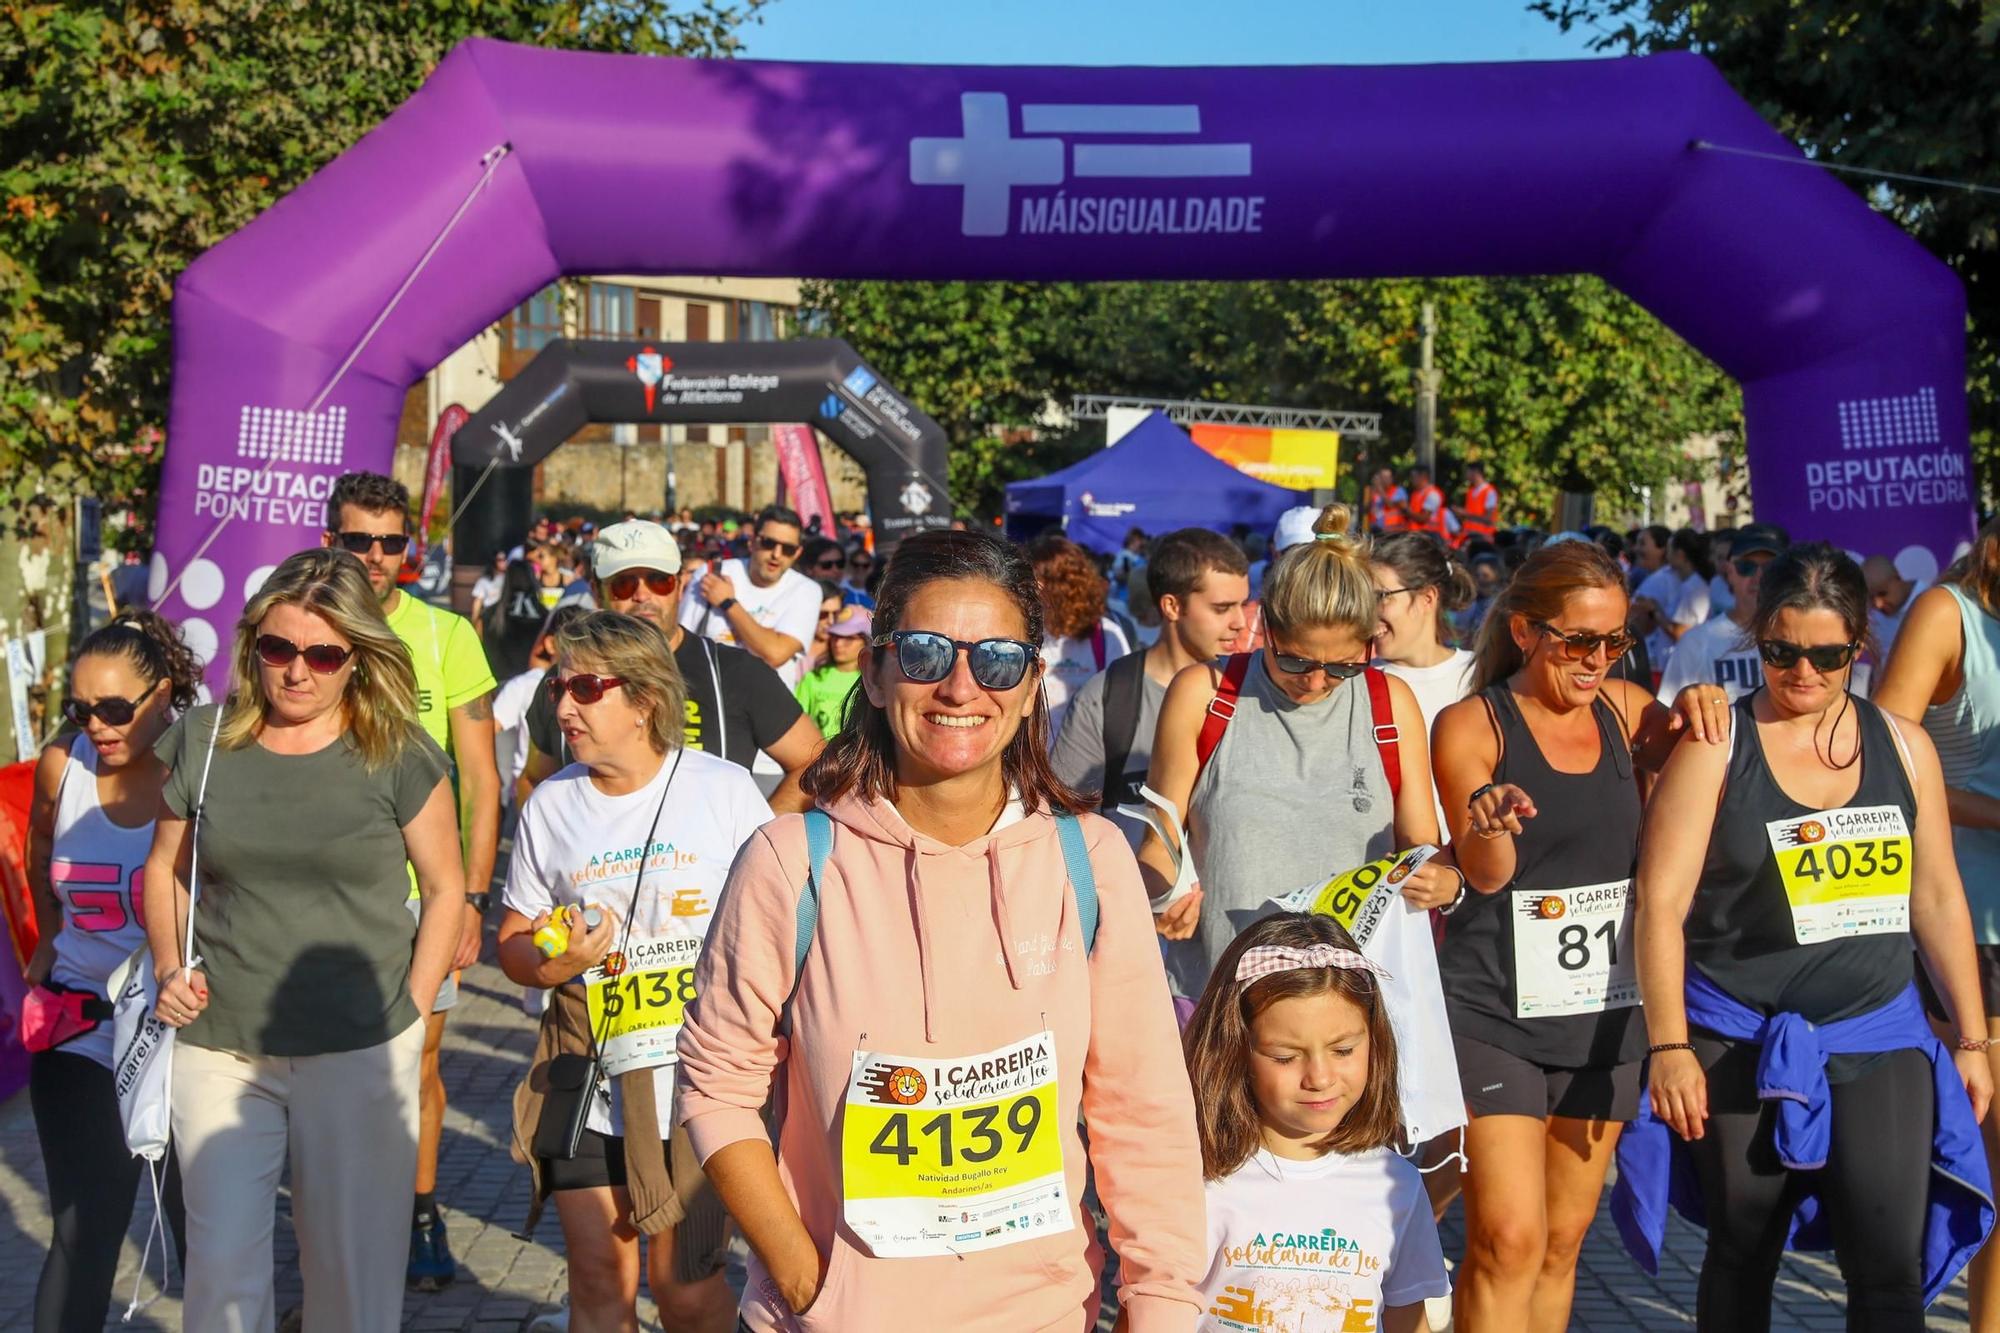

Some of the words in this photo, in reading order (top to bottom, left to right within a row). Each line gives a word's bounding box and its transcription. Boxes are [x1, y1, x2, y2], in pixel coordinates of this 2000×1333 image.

[1020, 190, 1265, 235] MÁISIGUALDADE
[1806, 446, 1965, 487] DEPUTACIÓN
[1809, 480, 1968, 512] PONTEVEDRA
[1836, 811, 1899, 826] CARREIRA
[590, 855, 600, 866] A
[603, 842, 675, 864] CARREIRA
[1794, 840, 1903, 882] 4035
[1557, 919, 1617, 971] 81
[602, 967, 698, 1017] 5138
[934, 1068, 941, 1087] I
[947, 1043, 1048, 1086] CARREIRA
[934, 1077, 1012, 1106] solidaria
[1013, 1069, 1028, 1087] de
[869, 1095, 1042, 1167] 4139
[918, 1173, 960, 1183] Natividad
[961, 1169, 992, 1181] Bugallo
[993, 1166, 1008, 1175] Rey
[941, 1181, 994, 1195] Andarines/as
[1223, 1239, 1323, 1268] solidaria
[1328, 1248, 1352, 1268] de
[1353, 1250, 1381, 1278] Leo
[1252, 1232, 1267, 1247] A
[1272, 1232, 1359, 1251] CARREIRA
